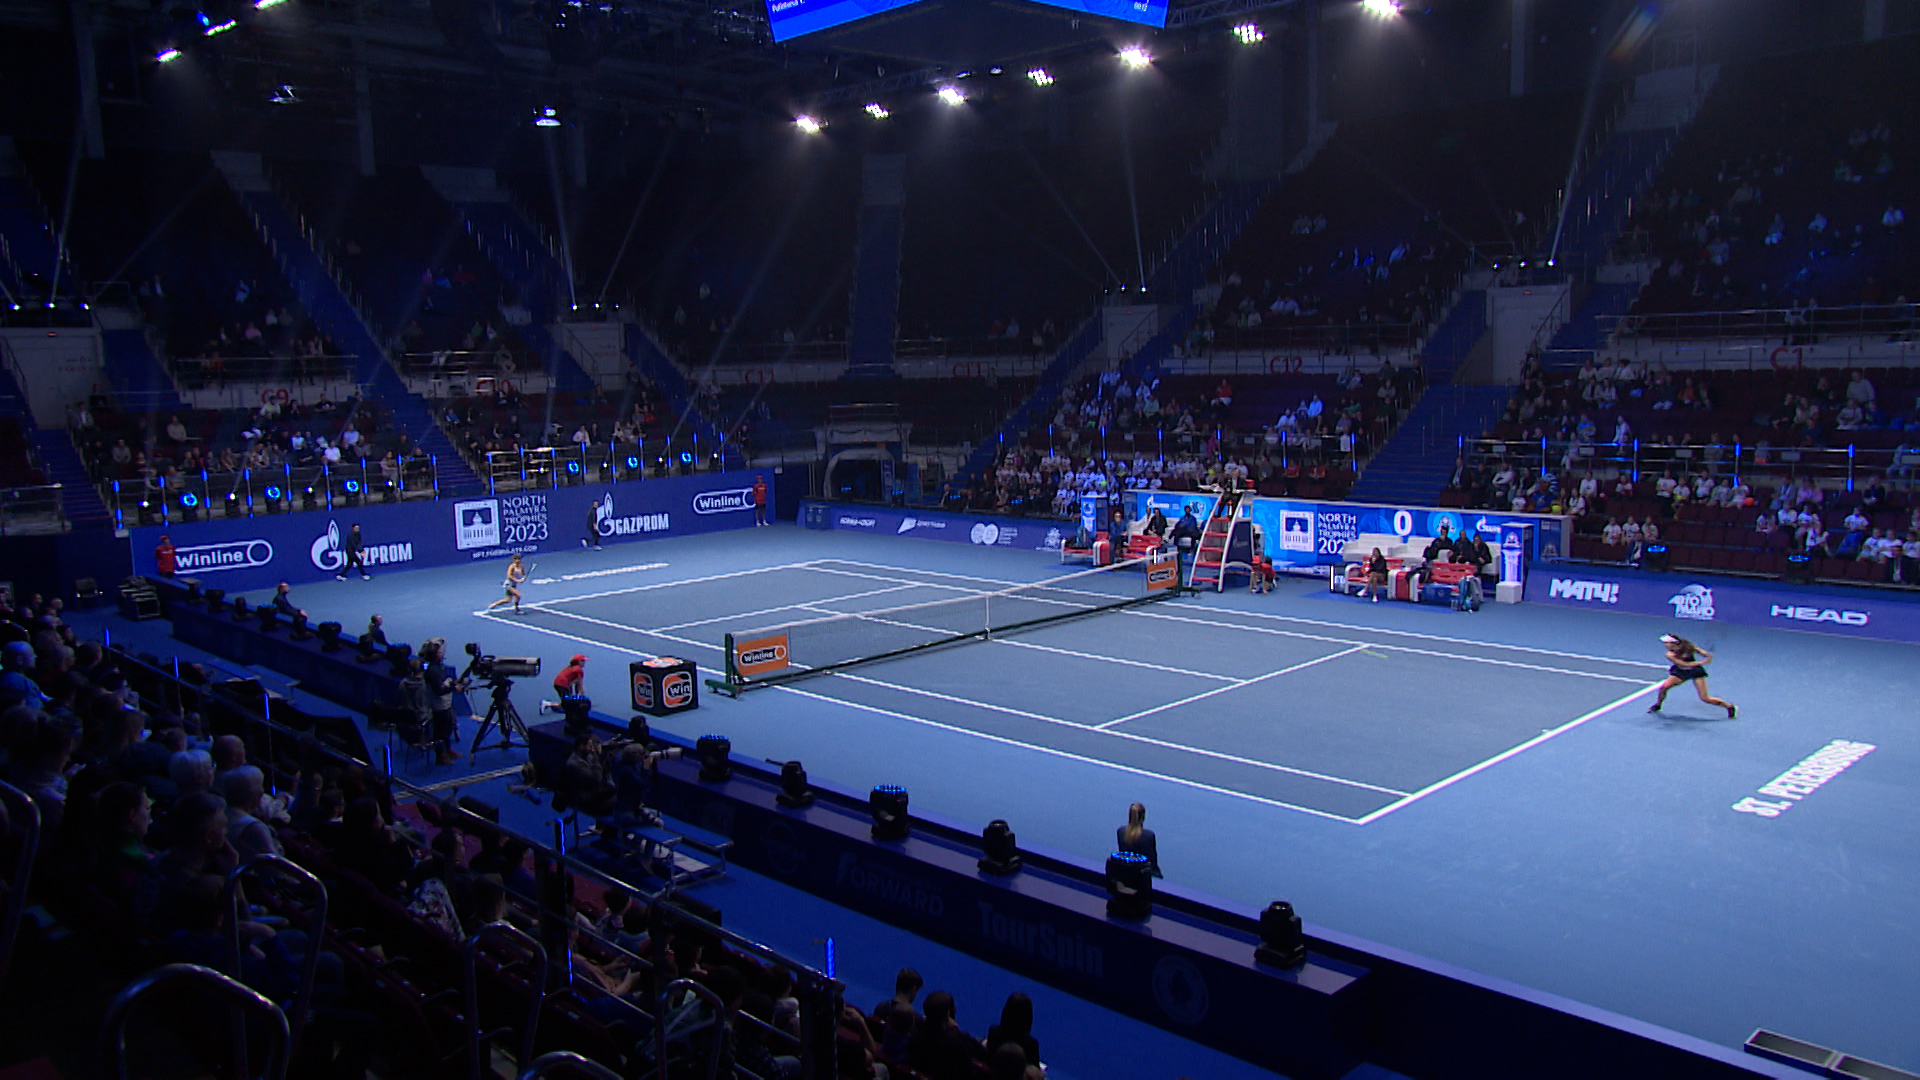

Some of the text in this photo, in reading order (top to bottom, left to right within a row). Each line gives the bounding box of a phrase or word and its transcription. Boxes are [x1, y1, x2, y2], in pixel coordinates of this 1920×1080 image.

[1270, 356, 1304, 374] C12
[502, 495, 547, 508] NORTH
[700, 495, 741, 509] Winline
[615, 513, 670, 535] GAZPROM
[1317, 512, 1357, 524] NORTH
[504, 522, 549, 544] 2023
[1317, 537, 1345, 554] 202
[174, 549, 244, 568] Winline
[1771, 604, 1868, 626] HEAD
[977, 898, 1104, 978] TourSpin
